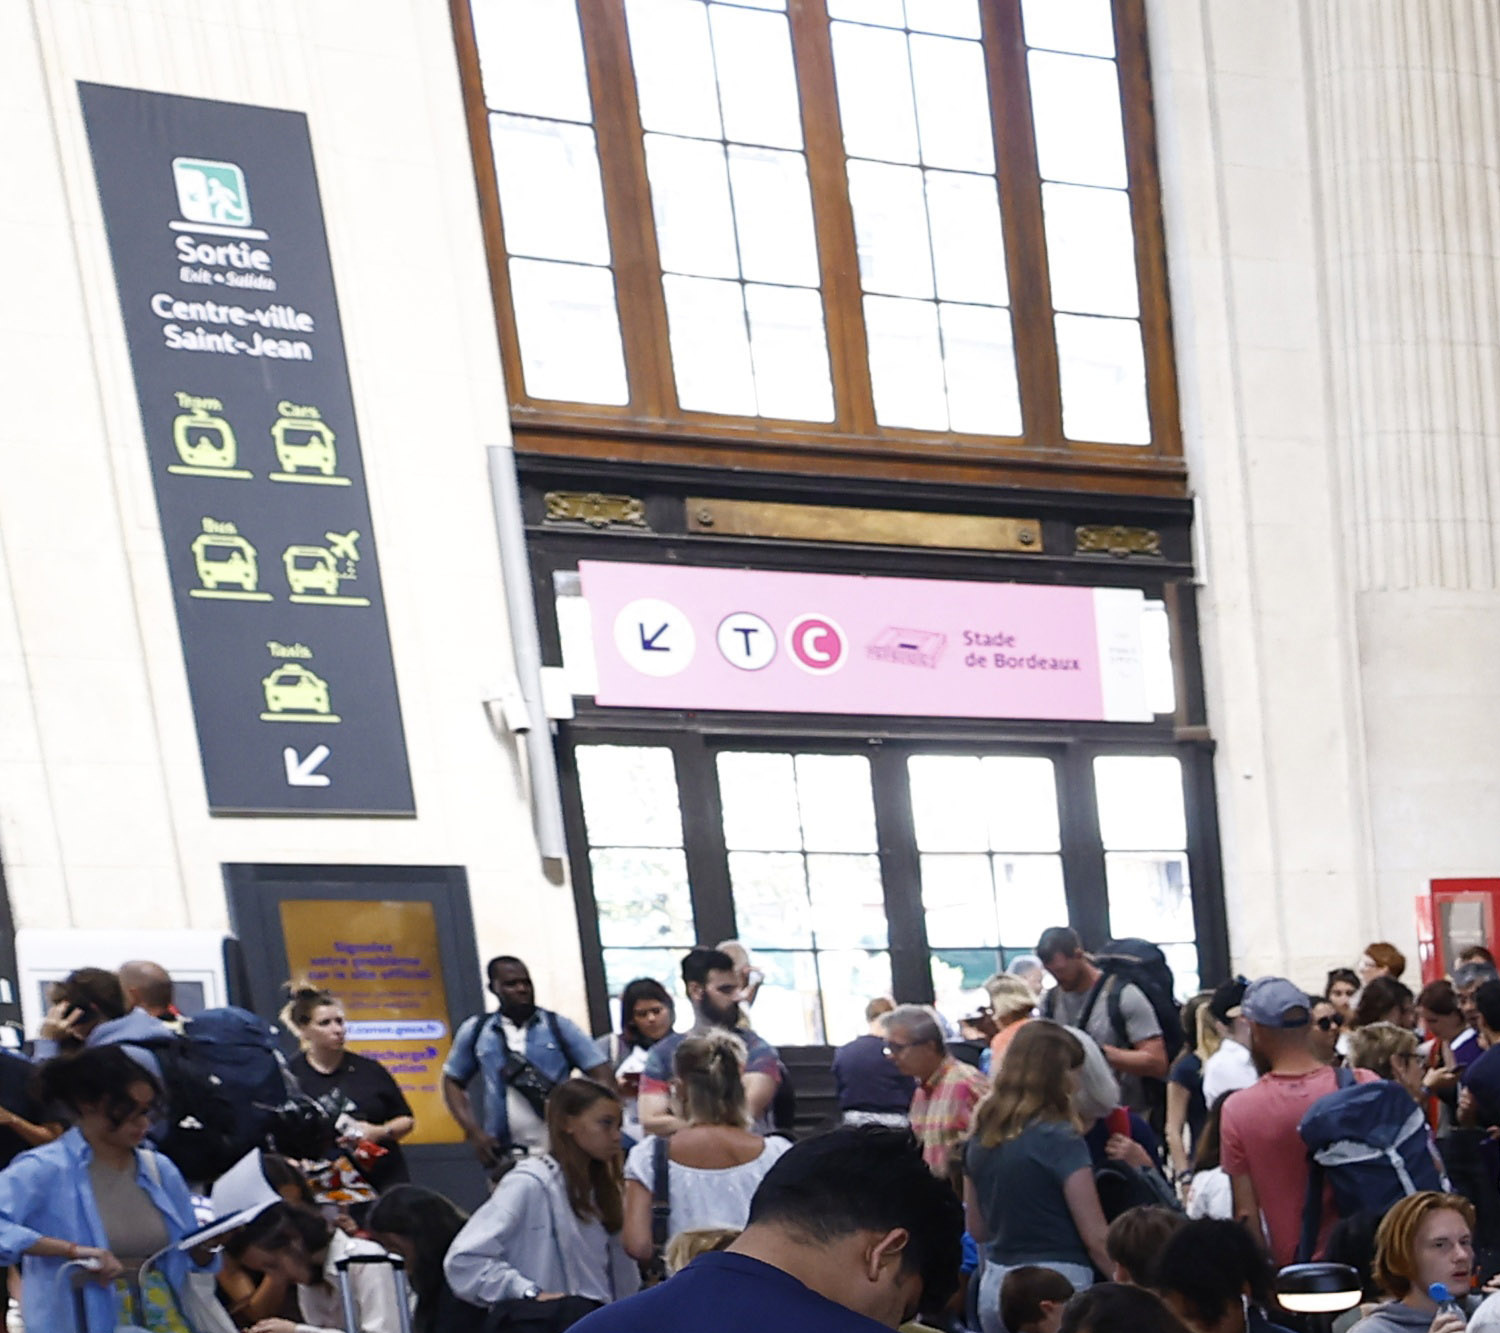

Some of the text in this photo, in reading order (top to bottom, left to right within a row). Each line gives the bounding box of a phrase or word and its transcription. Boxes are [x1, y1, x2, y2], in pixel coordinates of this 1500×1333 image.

[175, 235, 272, 271] Sortie
[151, 293, 315, 333] Centre-ville
[162, 323, 314, 362] Saint-Jean
[173, 391, 322, 420] Tram Cars
[201, 515, 239, 535] Bus
[733, 624, 832, 662] T C
[962, 629, 1016, 648] Stade
[964, 652, 1082, 672] de Bordeaux
